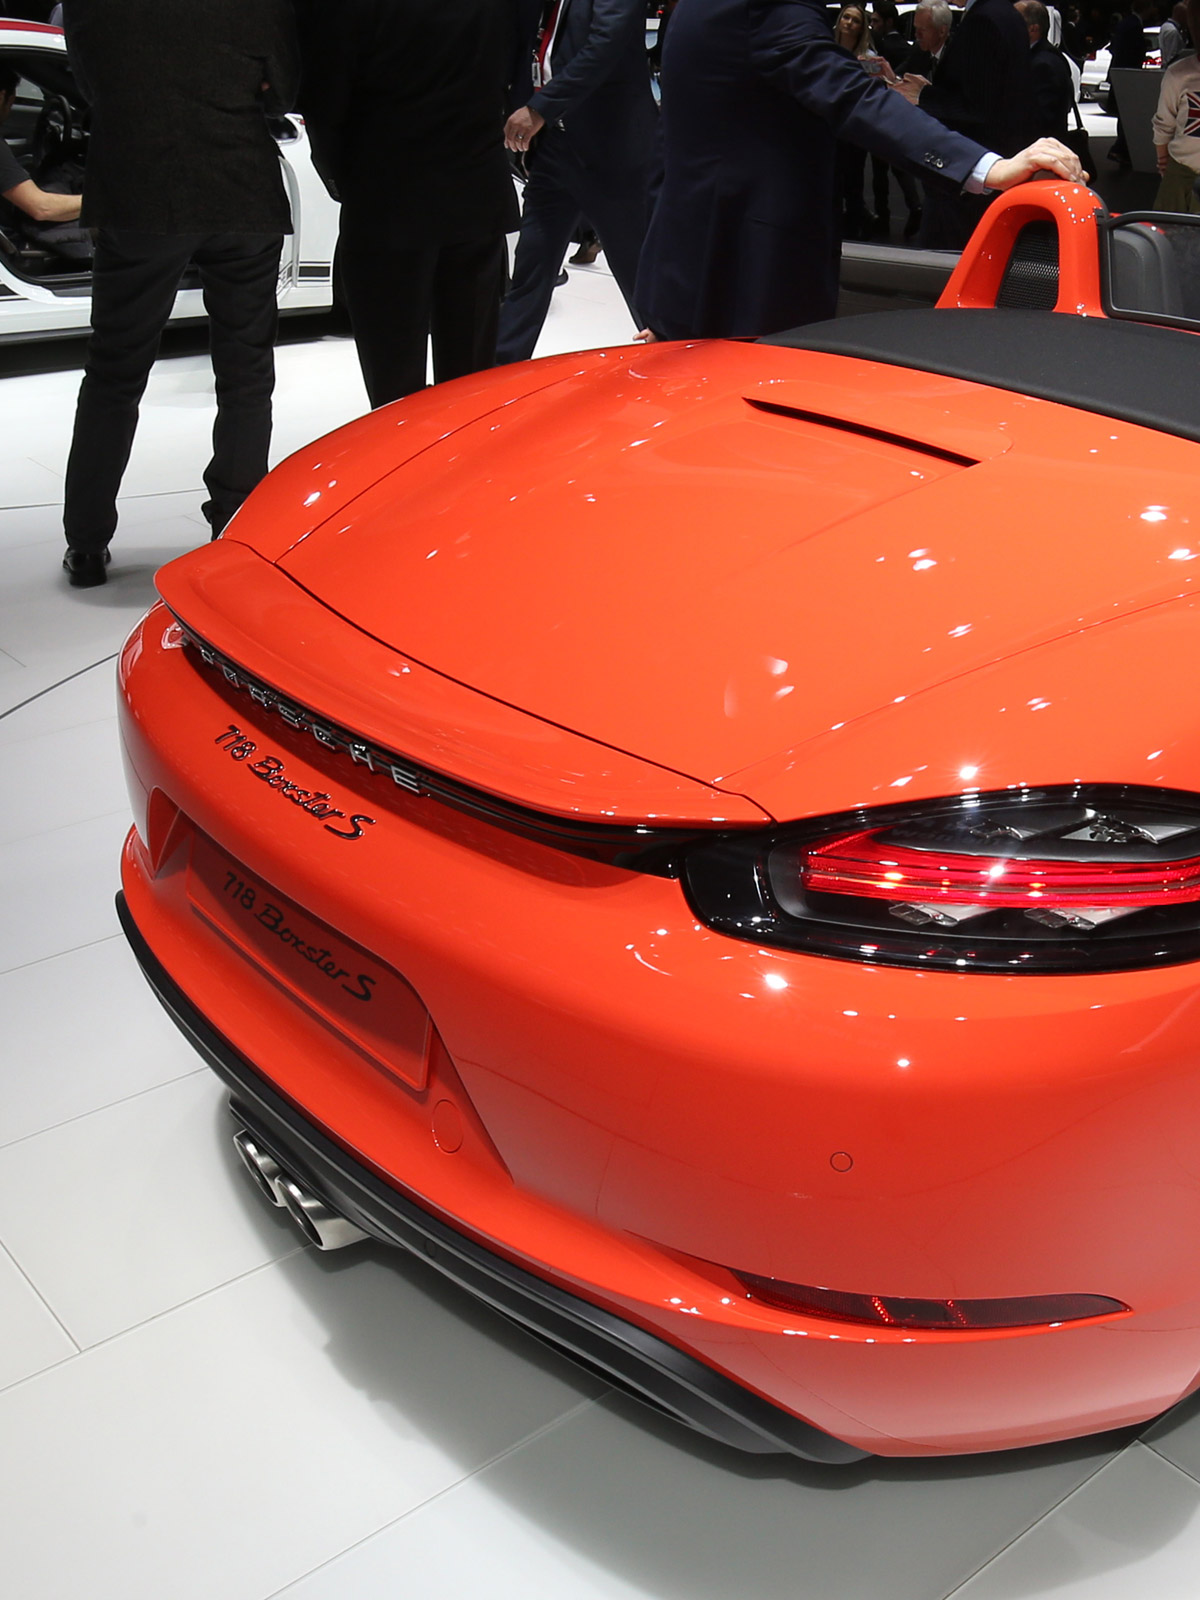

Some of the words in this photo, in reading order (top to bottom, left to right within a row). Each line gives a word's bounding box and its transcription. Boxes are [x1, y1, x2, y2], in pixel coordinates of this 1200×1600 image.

[199, 646, 421, 794] PORSCHE
[214, 725, 257, 761] 718
[248, 757, 345, 820] Boxster
[324, 815, 377, 840] S
[223, 871, 257, 910] 718
[253, 903, 349, 981] Boxster
[341, 974, 377, 1002] S
